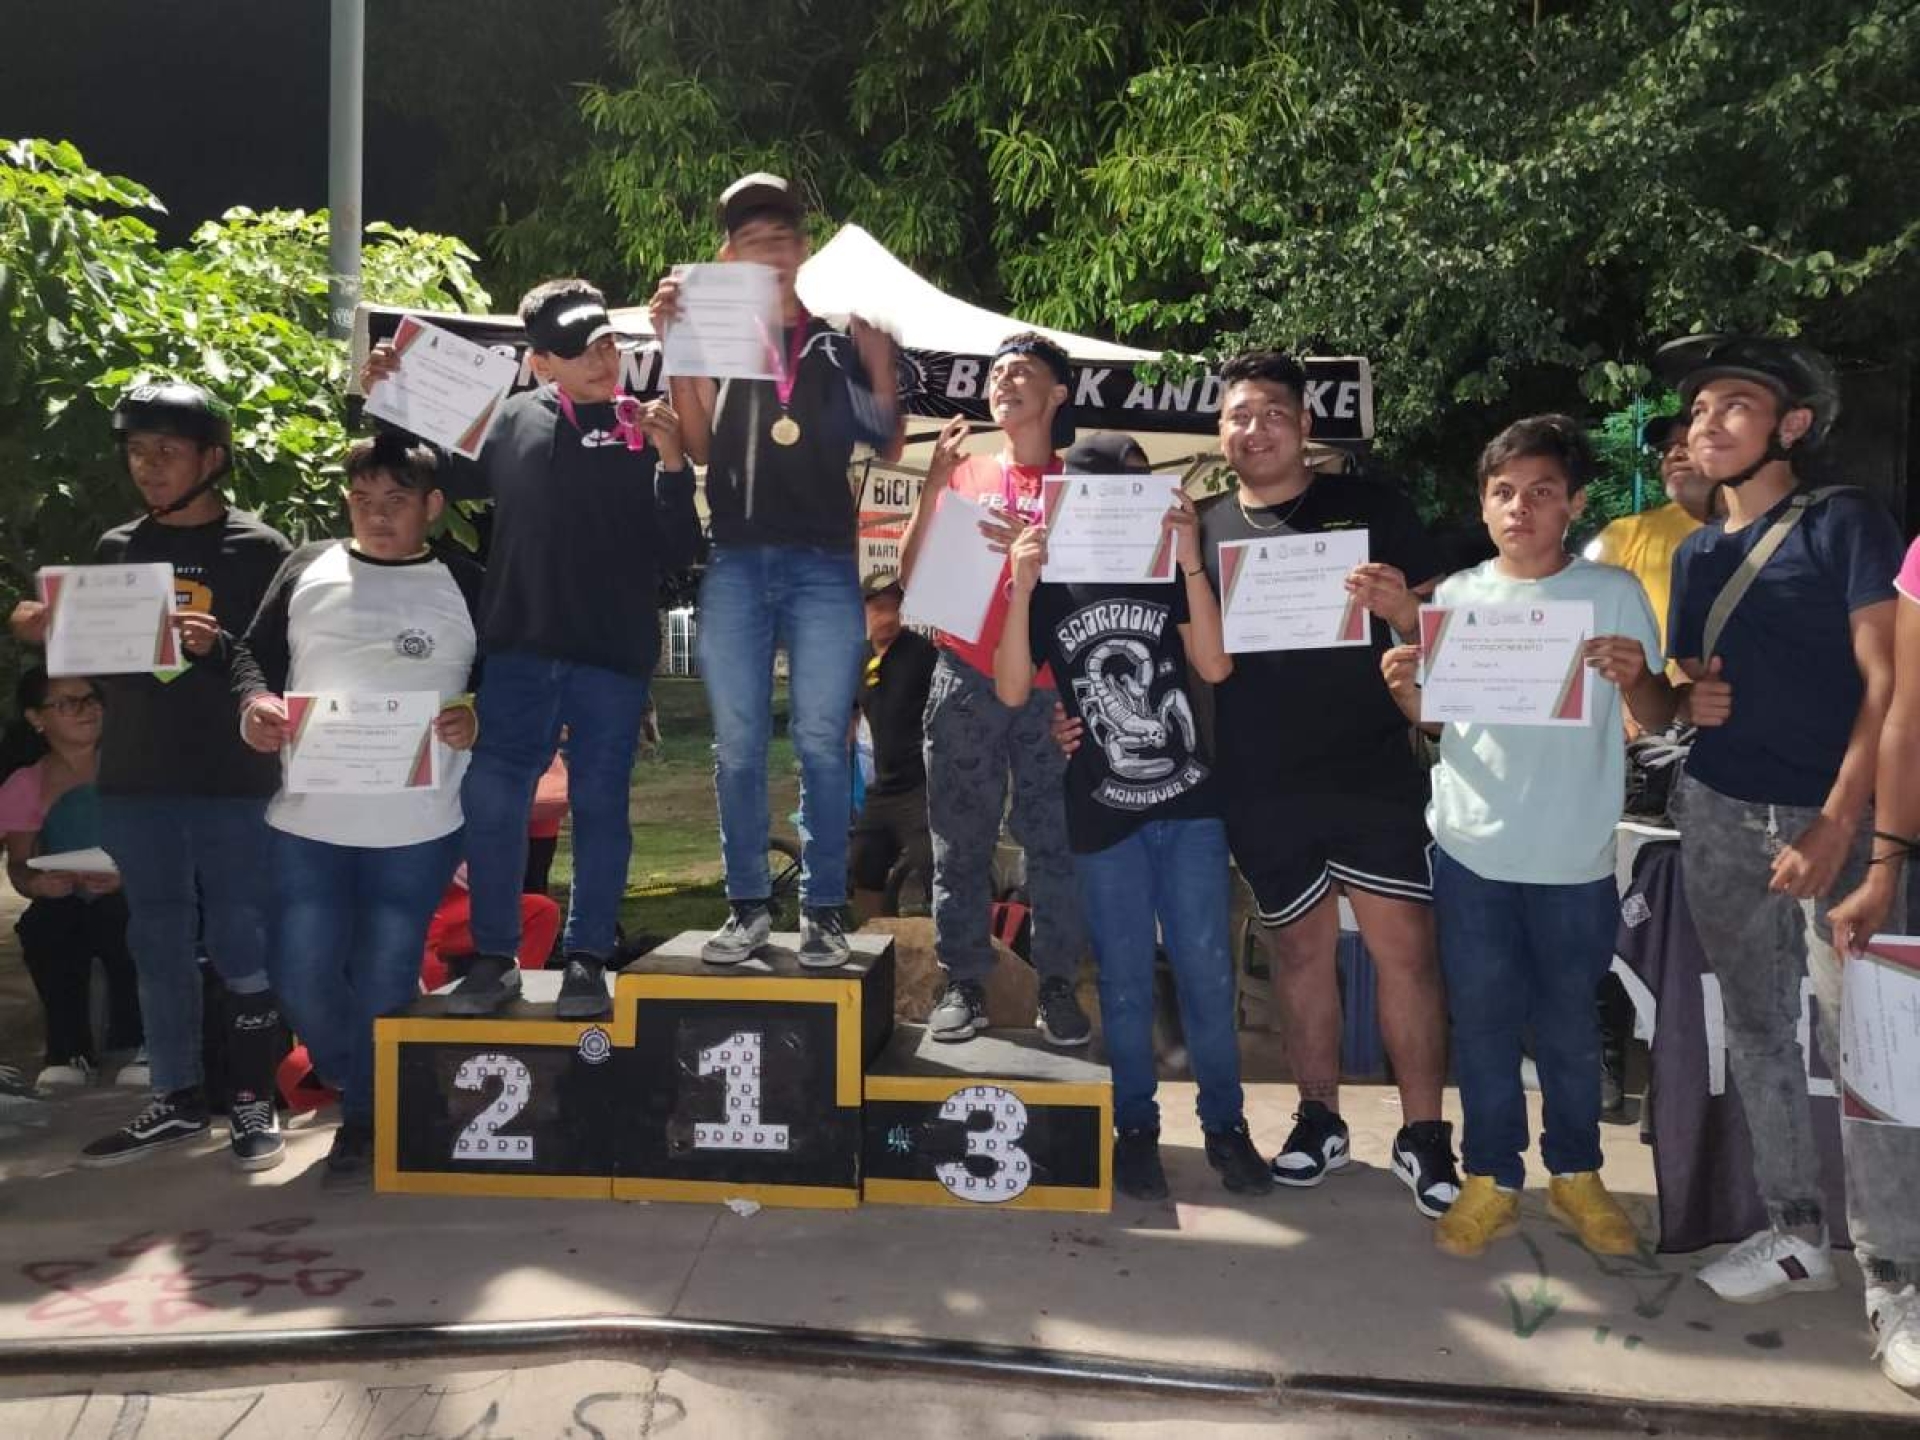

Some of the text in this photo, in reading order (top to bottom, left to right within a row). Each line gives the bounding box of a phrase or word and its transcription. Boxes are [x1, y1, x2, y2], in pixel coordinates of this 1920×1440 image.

[1057, 604, 1169, 652] SCORPIONS
[452, 1053, 533, 1159] 2
[695, 1033, 789, 1149] 1
[935, 1085, 1033, 1203] 3
